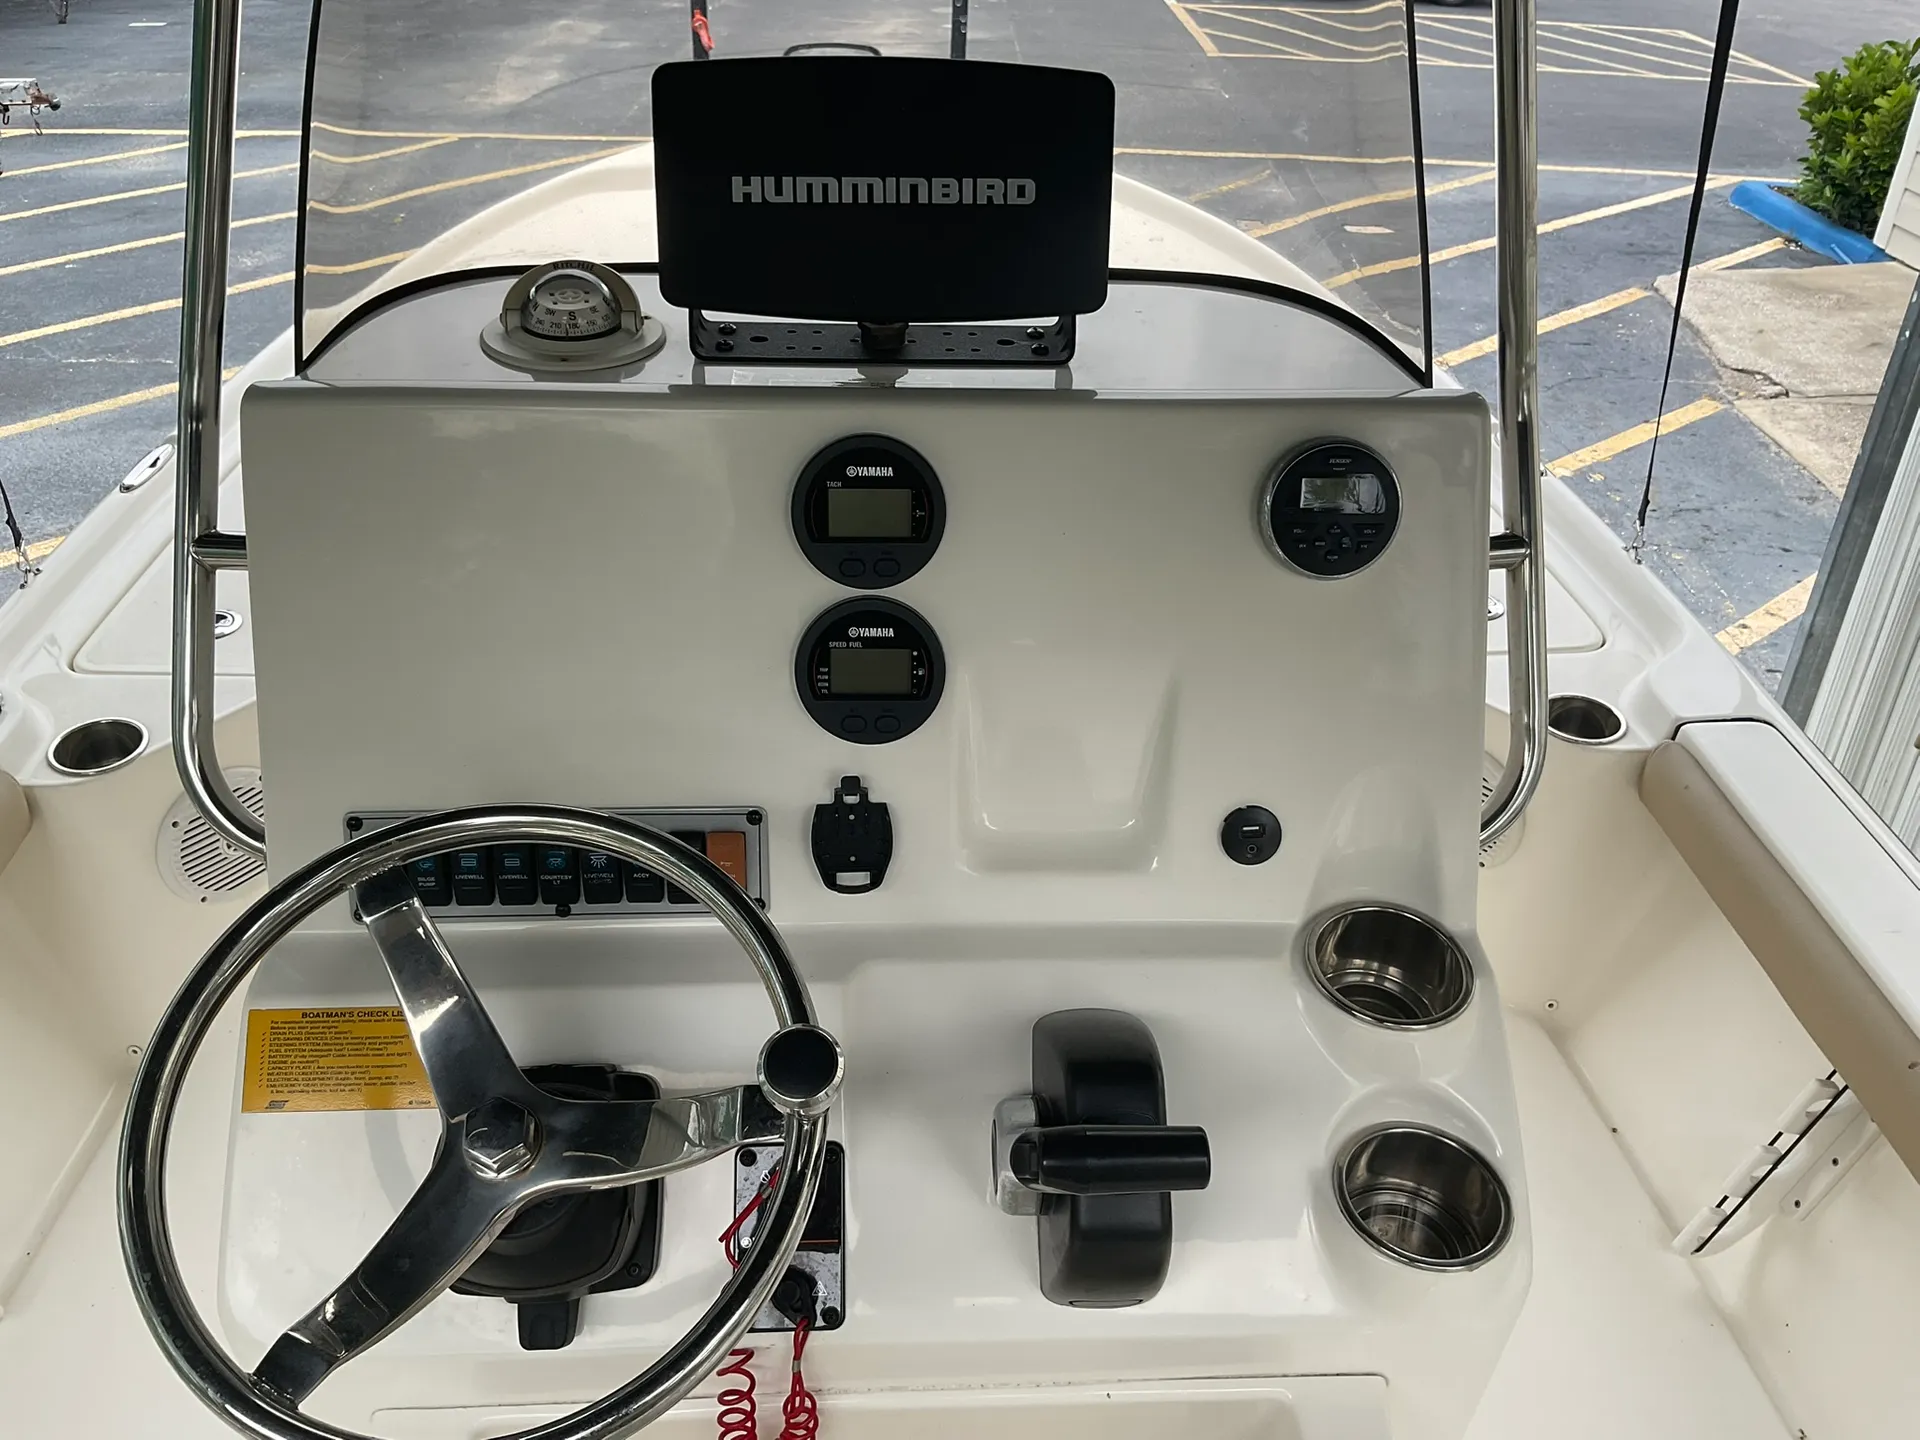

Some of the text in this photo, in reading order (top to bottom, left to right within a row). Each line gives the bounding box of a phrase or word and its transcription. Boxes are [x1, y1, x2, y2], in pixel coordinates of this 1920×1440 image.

[732, 176, 1036, 205] HUMMINBIRD
[568, 311, 577, 321] S
[549, 321, 562, 329] 210
[568, 321, 580, 329] 180
[857, 466, 893, 477] YAMAHA
[859, 627, 894, 637] YAMAHA
[301, 1010, 355, 1019] BOATMAN'S
[357, 1010, 389, 1018] CHECK
